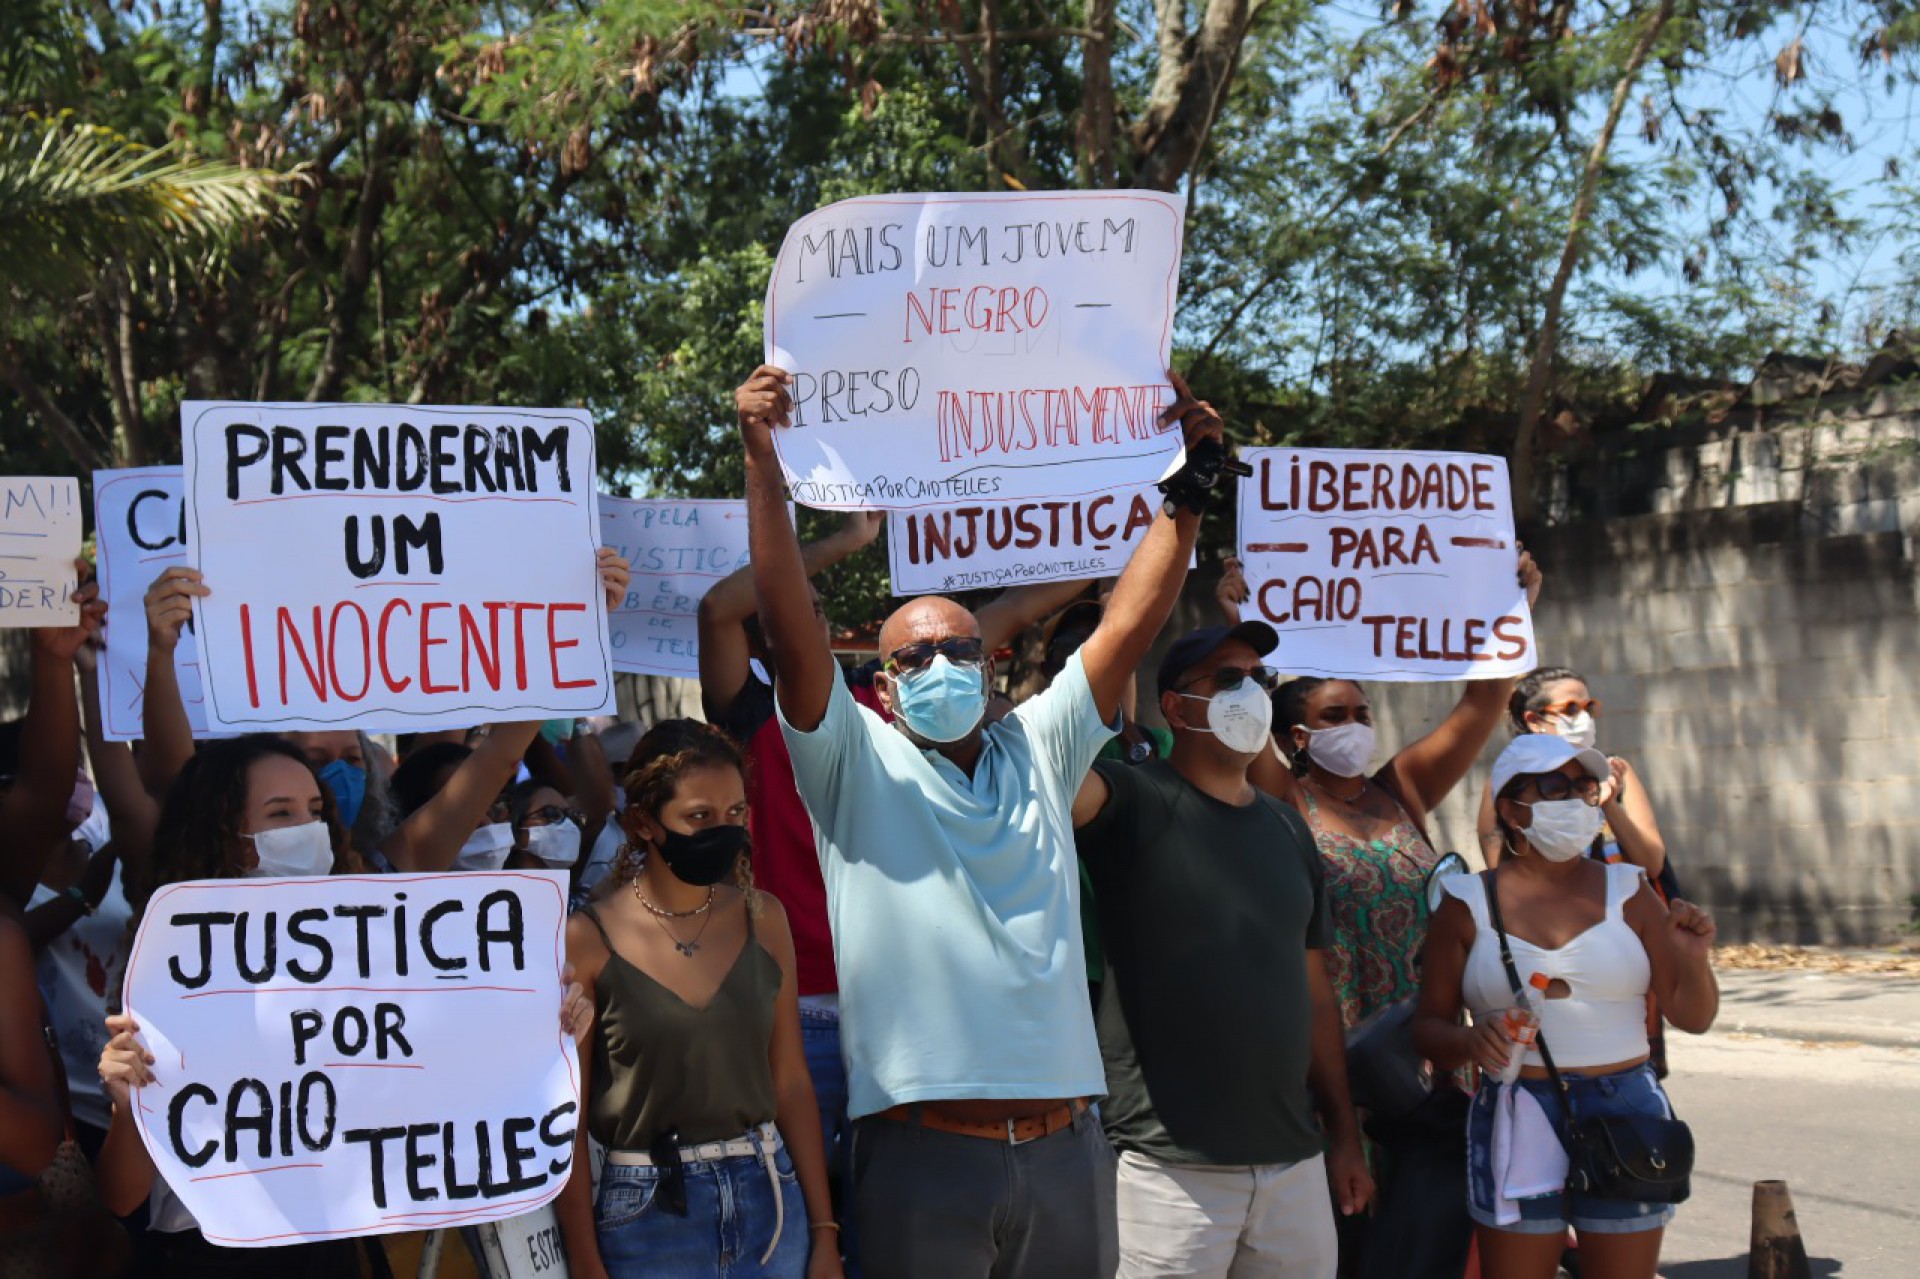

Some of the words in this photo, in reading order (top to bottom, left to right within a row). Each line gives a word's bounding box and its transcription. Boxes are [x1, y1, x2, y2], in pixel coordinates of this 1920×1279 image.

[796, 223, 903, 284] MAIS
[926, 225, 990, 268] UM
[1001, 218, 1135, 263] JOVEM
[903, 285, 1049, 343] NEGRO
[790, 366, 921, 428] PRESO
[937, 384, 1180, 462] INJUSTAMENTE
[224, 423, 571, 500] PRENDERAM
[1260, 455, 1495, 512] LIBERDADE
[344, 511, 445, 579] UM
[633, 507, 700, 528] PELA
[1328, 523, 1441, 569] PARA
[1257, 575, 1362, 623] CAIO
[240, 598, 598, 708] INOCENTE
[1361, 616, 1527, 661] TELLES
[291, 1003, 414, 1065] POR
[167, 1071, 337, 1169] CAIO
[341, 1101, 577, 1209] TELLES
